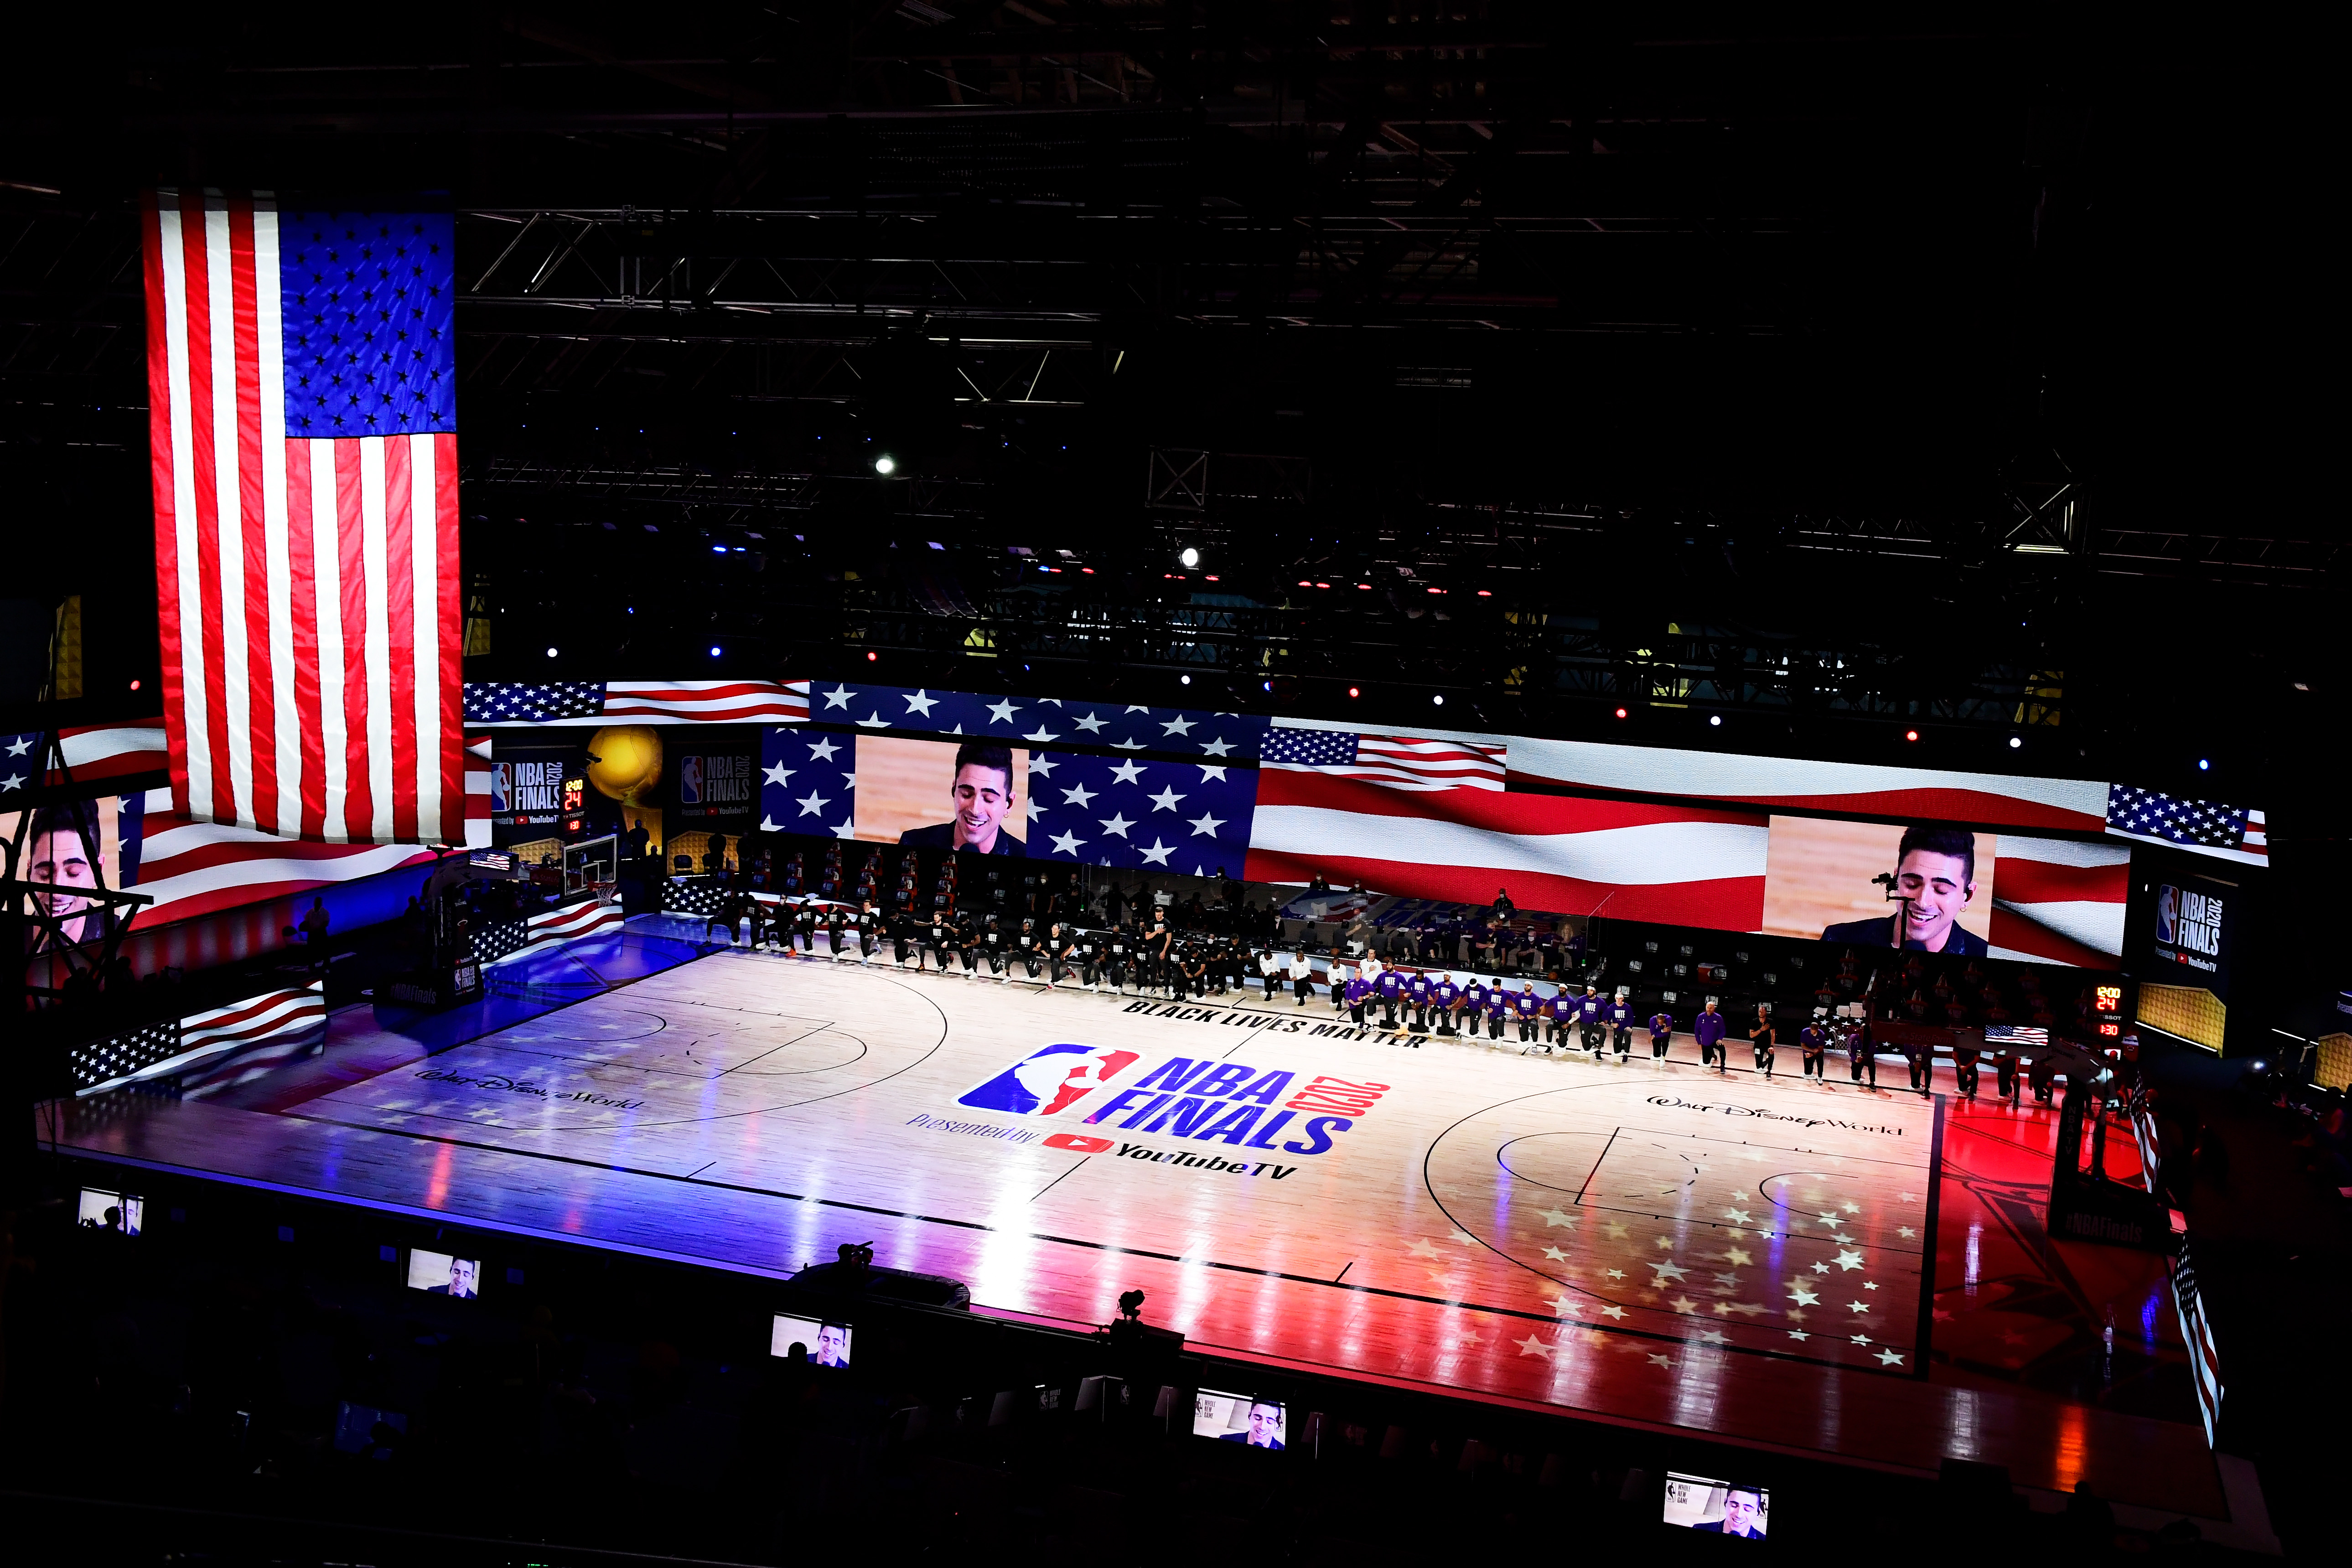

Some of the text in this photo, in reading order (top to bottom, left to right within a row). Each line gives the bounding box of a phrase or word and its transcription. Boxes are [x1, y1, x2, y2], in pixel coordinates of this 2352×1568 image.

[516, 763, 544, 786] NBA
[546, 762, 562, 785] 2020
[707, 756, 733, 778] NBA
[735, 756, 750, 778] 2020
[566, 779, 583, 792] 12:00
[707, 778, 750, 802] FINALS
[565, 792, 581, 811] 24
[528, 815, 559, 824] YouTubeT
[2181, 890, 2206, 923] NBA
[2206, 897, 2222, 927] 2020
[2178, 918, 2220, 956] FINALS
[1385, 977, 1396, 985] VOTE
[1414, 982, 1425, 991] VOTE
[1441, 987, 1451, 996] VOTE
[1470, 990, 1480, 999] VOTE
[1491, 994, 1502, 1004] VOTE
[2098, 987, 2120, 999] 12:00
[1521, 999, 1532, 1008] VOTE
[1557, 1001, 1567, 1010] VOTE
[1585, 1003, 1596, 1012] VOTE
[2097, 997, 2115, 1010] 24
[1615, 1010, 1625, 1018] VOTE
[1122, 1002, 1428, 1049] BLACK LIVES MATTER
[2100, 1025, 2118, 1035] 1:30
[1132, 1057, 1296, 1105] NBA
[572, 1092, 645, 1109] World
[1285, 1076, 1391, 1117] 2020
[906, 1113, 1041, 1144] Presented by
[1082, 1089, 1353, 1155] FINALS
[1824, 1119, 1903, 1136] World
[2065, 1211, 2143, 1244] #NBAFinals
[1678, 1484, 1691, 1492] WHOLE
